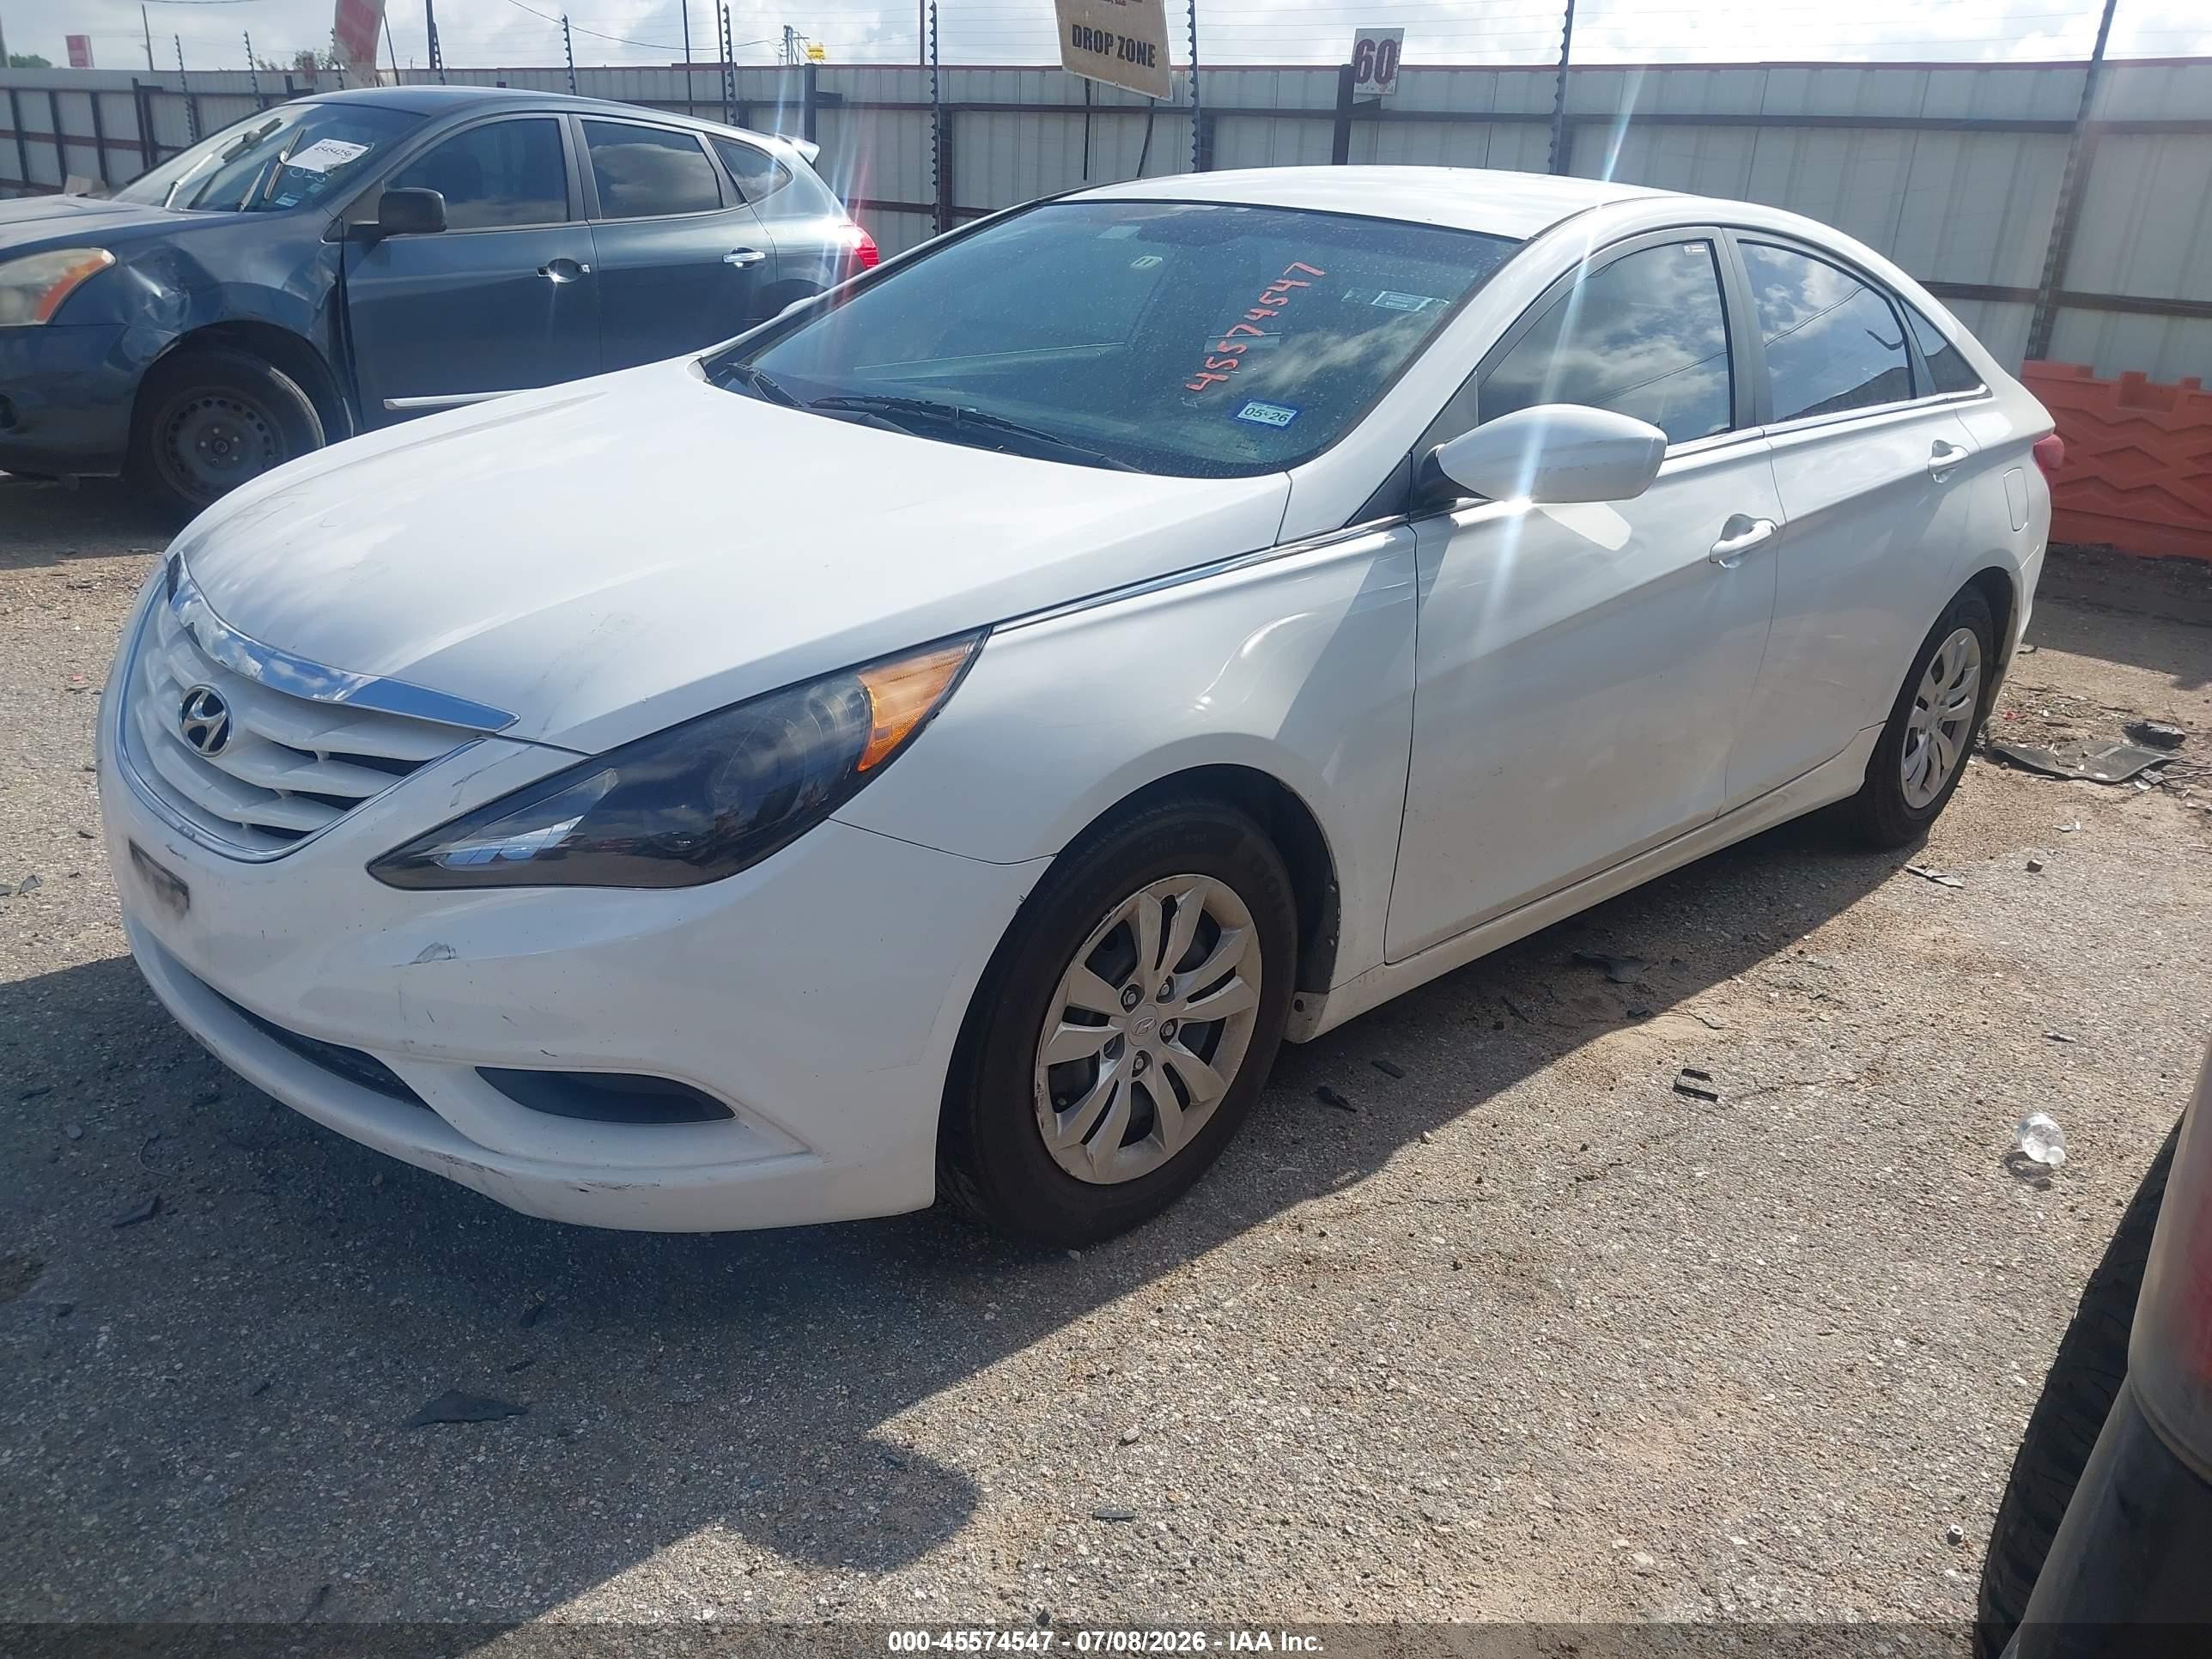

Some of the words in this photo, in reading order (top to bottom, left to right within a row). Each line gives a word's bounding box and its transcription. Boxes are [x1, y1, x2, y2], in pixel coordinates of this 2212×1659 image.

[1072, 24, 1114, 56] DROP
[1116, 35, 1156, 69] ZONE
[1354, 39, 1397, 84] 60
[1185, 261, 1327, 391] 45574547
